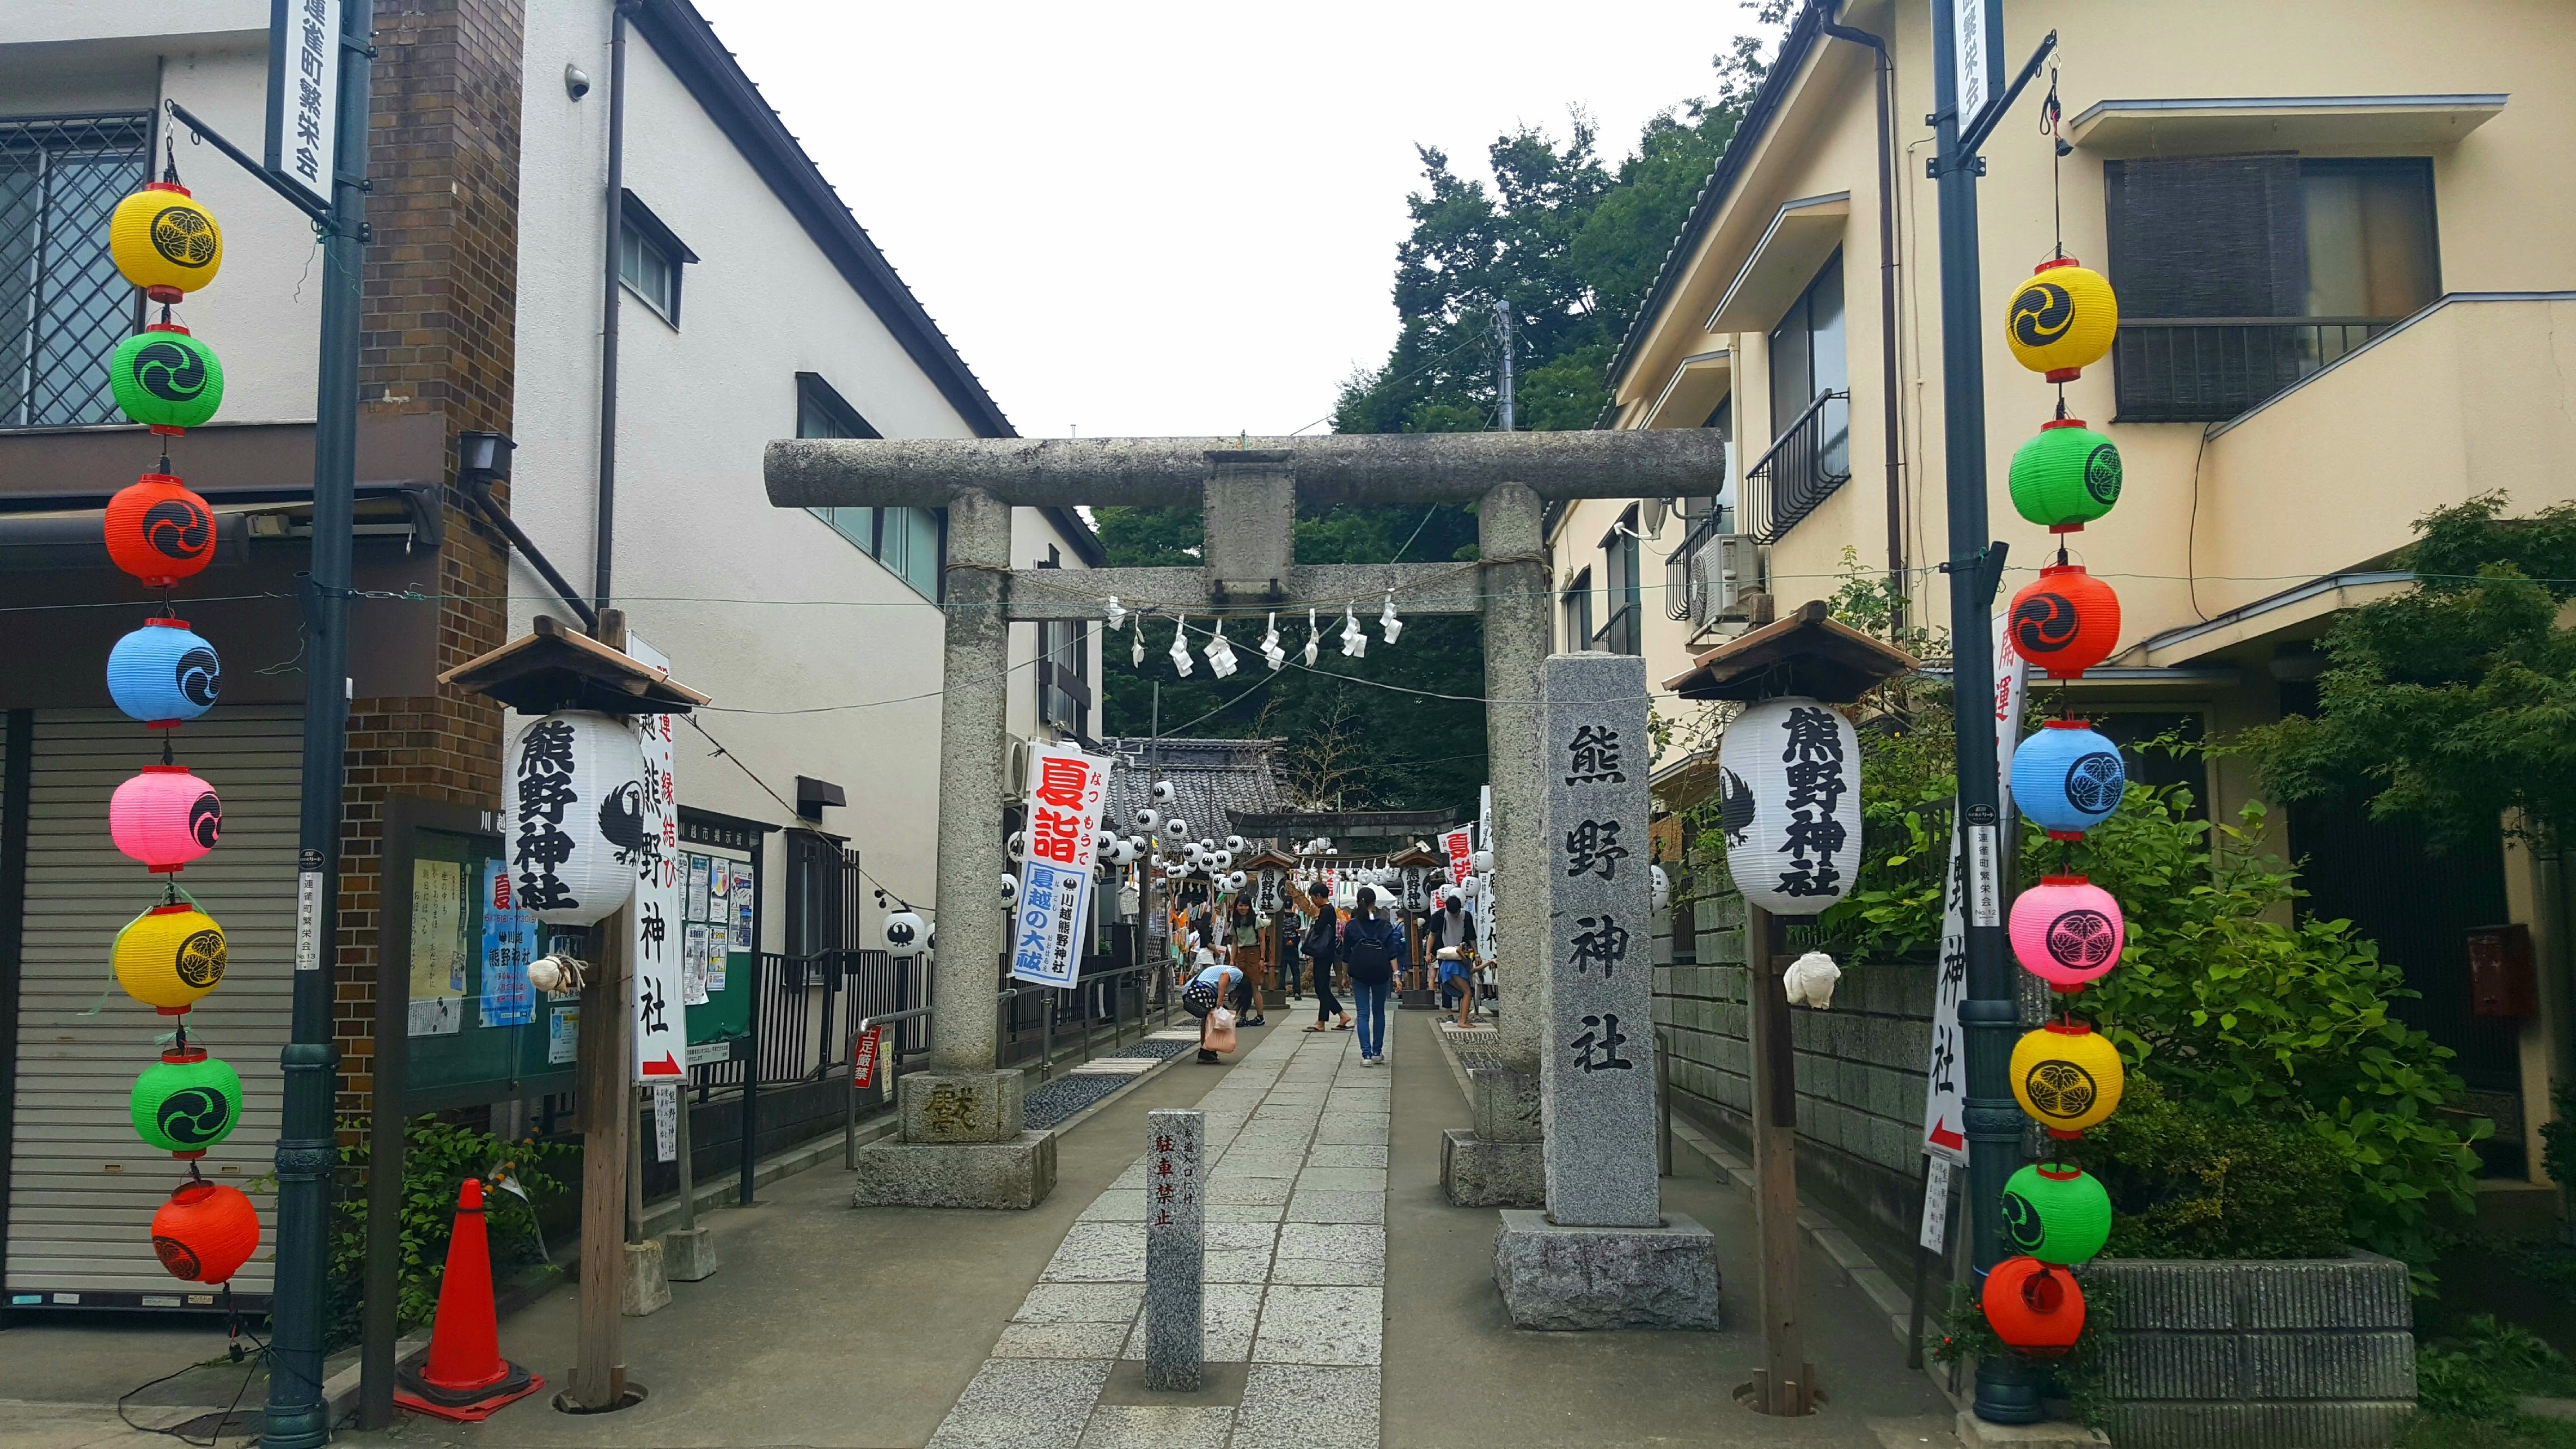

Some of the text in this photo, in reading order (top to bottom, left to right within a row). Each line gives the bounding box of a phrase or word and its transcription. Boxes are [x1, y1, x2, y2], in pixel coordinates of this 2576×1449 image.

[513, 721, 579, 911] 熊野神社
[1034, 756, 1090, 864] 夏詣
[1773, 707, 1847, 898] 熊野神社
[301, 879, 314, 951] 連雀町繁栄会
[1565, 725, 1632, 1074] 熊野神社
[1978, 833, 1991, 906] 連雀町繁栄会
[1016, 868, 1054, 972] 夏越の大祓
[1052, 893, 1075, 973] 川越熊野神社
[854, 1028, 876, 1081] 土足厳禁
[1155, 1135, 1175, 1226] 駐車禁止
